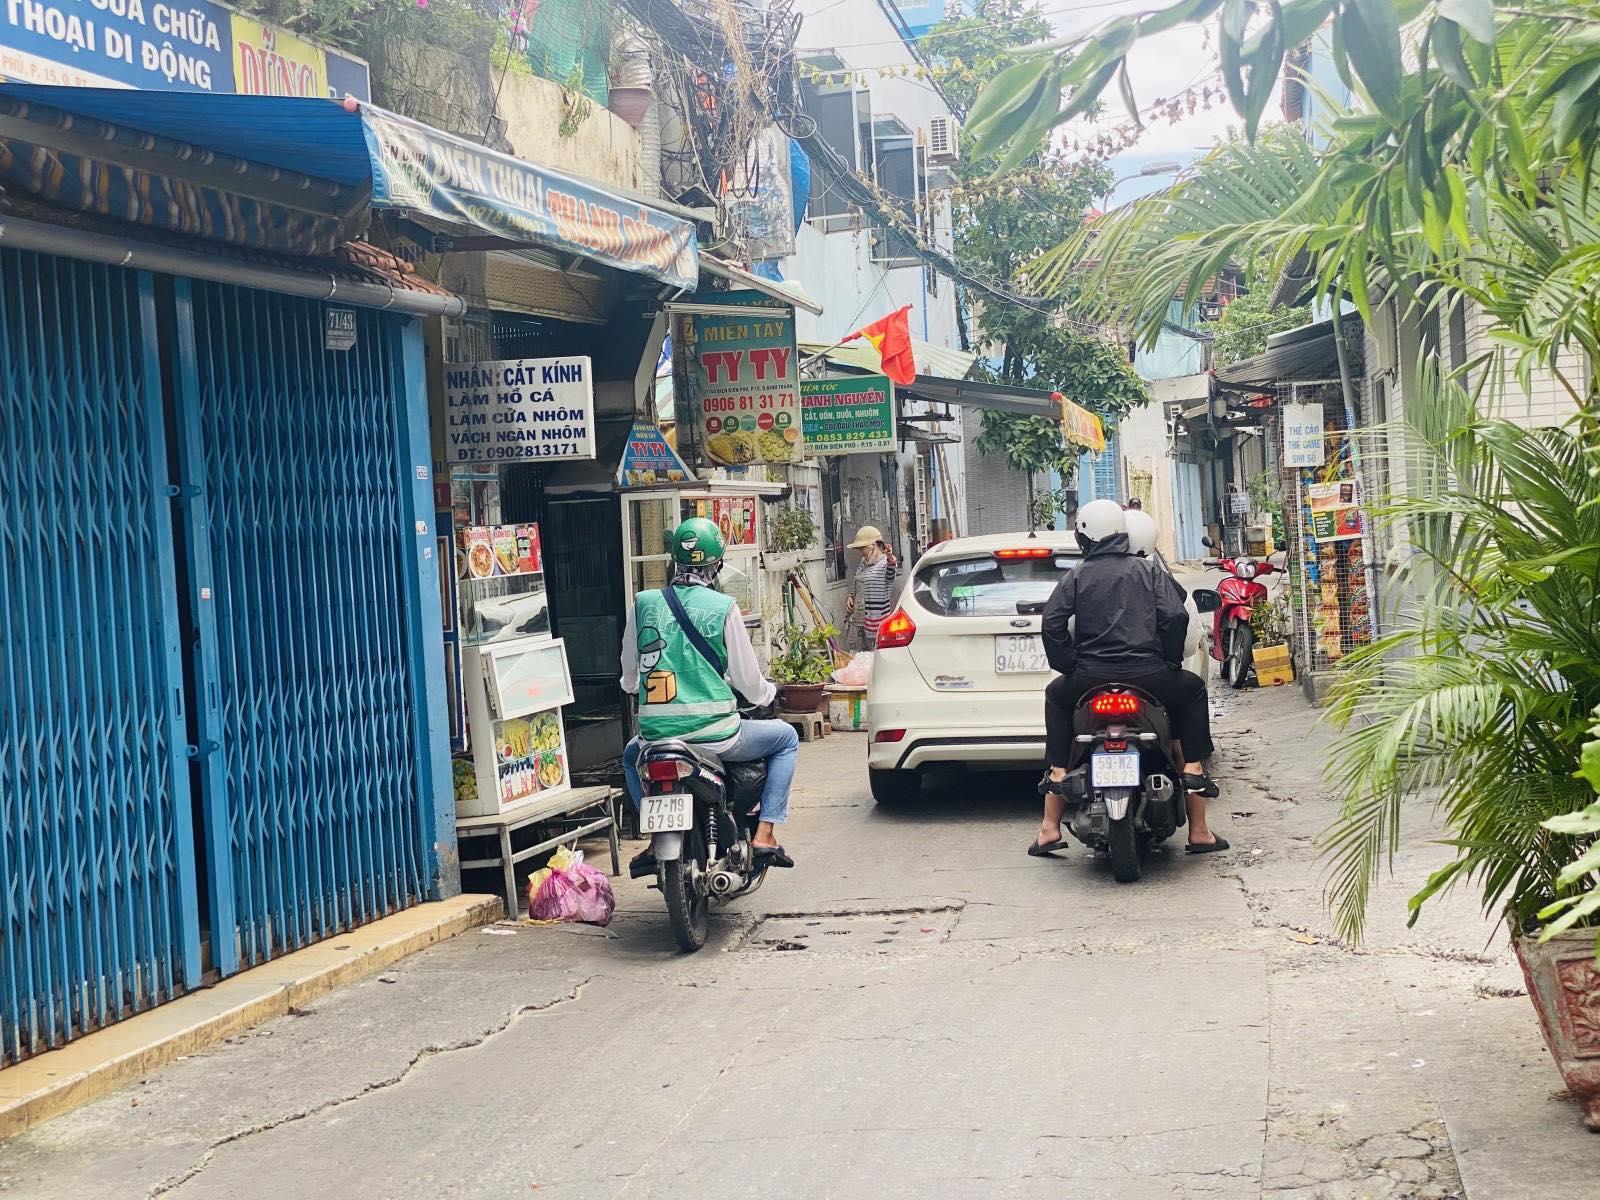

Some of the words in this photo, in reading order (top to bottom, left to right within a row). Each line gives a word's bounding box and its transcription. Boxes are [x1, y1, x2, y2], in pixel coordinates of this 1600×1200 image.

[153, 3, 221, 51] CHỮA
[6, 0, 96, 52] THOẠI
[104, 26, 134, 64] DI
[141, 41, 212, 91] ĐỘNG
[503, 360, 536, 386] CẮT
[542, 361, 583, 384] KÍNH
[701, 350, 745, 384] TY
[748, 347, 792, 381] TY
[450, 389, 489, 406] LÀM
[497, 388, 523, 404] HỒ
[530, 387, 555, 402] CÁ
[704, 396, 735, 412] 0906
[739, 395, 754, 410] 81
[759, 394, 774, 409] 31
[779, 392, 793, 407] 71
[451, 411, 487, 426] LÀM
[492, 407, 527, 424] CỬA
[533, 407, 584, 422] NHÔM
[451, 428, 491, 444] VÁCH
[541, 425, 586, 440] NHÔM
[816, 433, 842, 442] 0853
[868, 430, 888, 439] 433
[458, 448, 482, 460] ĐT:
[487, 443, 579, 458] 0902813171
[1292, 454, 1306, 463] SIM
[1008, 636, 1037, 653] 30A
[997, 653, 1048, 672] 944.27
[648, 798, 685, 814] 77-M9
[647, 814, 685, 830] 6799
